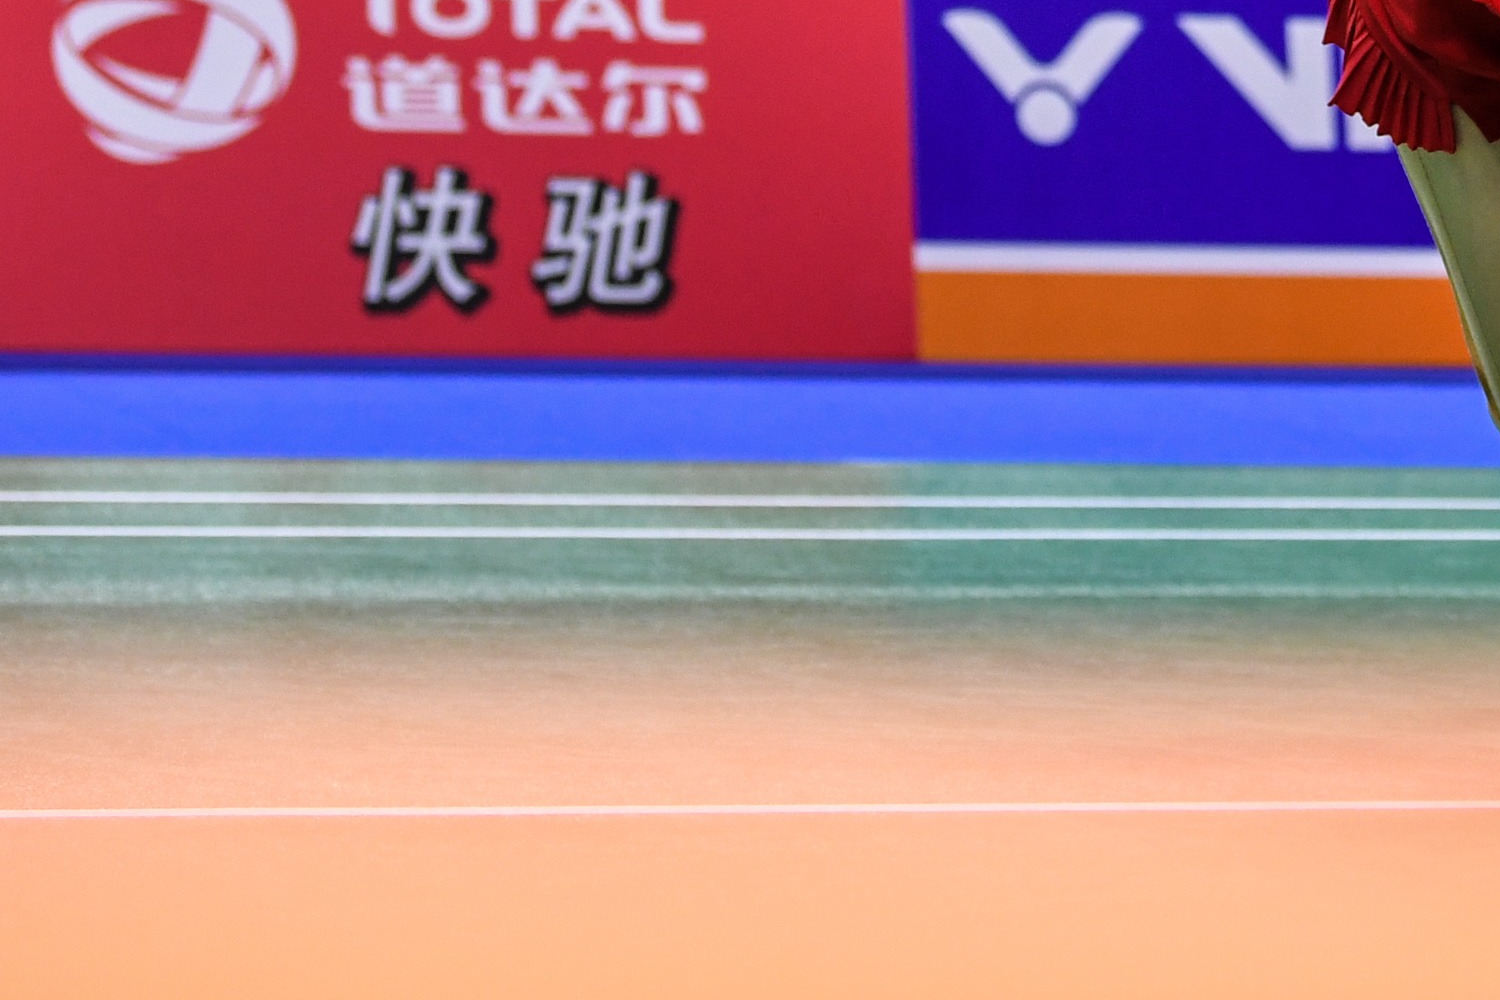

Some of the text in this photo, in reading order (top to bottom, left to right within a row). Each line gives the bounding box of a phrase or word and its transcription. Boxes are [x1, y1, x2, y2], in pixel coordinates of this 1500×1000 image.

[343, 55, 709, 137] 道达尔
[350, 165, 680, 314] 快驰
